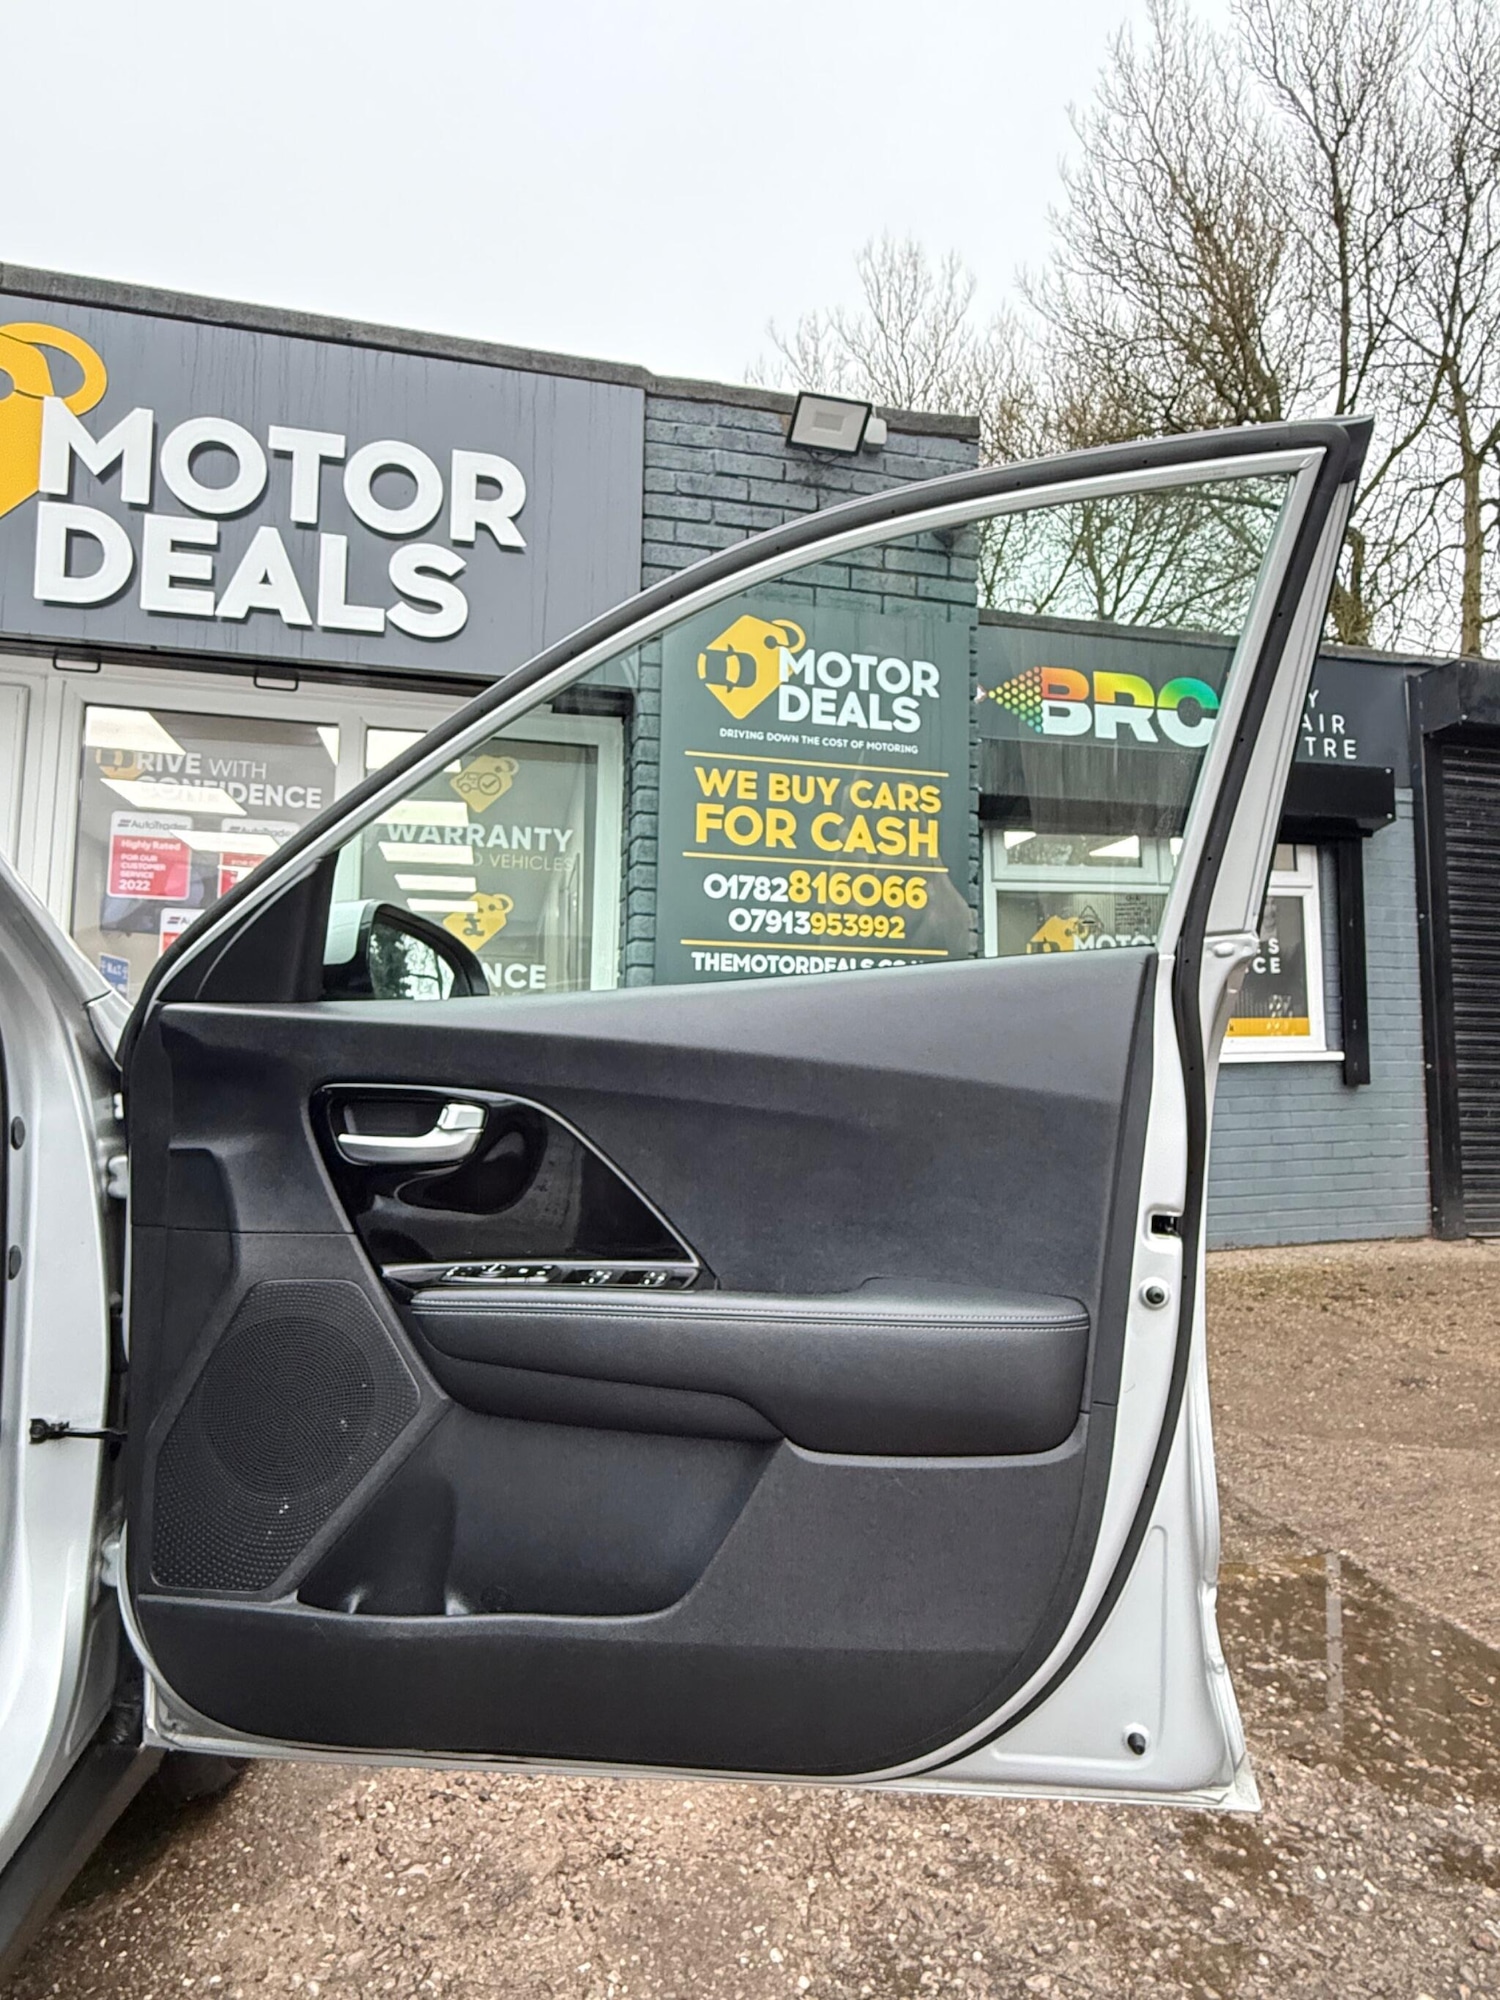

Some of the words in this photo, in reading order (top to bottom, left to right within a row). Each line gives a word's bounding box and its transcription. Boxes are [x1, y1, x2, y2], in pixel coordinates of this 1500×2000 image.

[39, 396, 527, 549] MOTOR
[33, 501, 469, 639] DEALS
[778, 647, 940, 699] MOTOR
[777, 686, 922, 734] DEALS
[719, 728, 764, 741] DRIVING
[766, 733, 799, 744] DOWN
[801, 735, 820, 746] THE
[822, 737, 848, 748] COST
[850, 740, 864, 750] OF
[866, 742, 919, 755] MOTORING
[209, 758, 267, 779] WITH
[695, 766, 758, 800] WE
[768, 772, 840, 806] BUY
[850, 780, 942, 814] CARS
[387, 823, 573, 852] WARRANTY
[695, 802, 797, 849] FOR
[810, 811, 939, 858] CASH
[489, 853, 574, 872] VEHICLES
[119, 879, 151, 892] 2022
[703, 870, 928, 910] 01782816066
[728, 907, 905, 939] 07913953992
